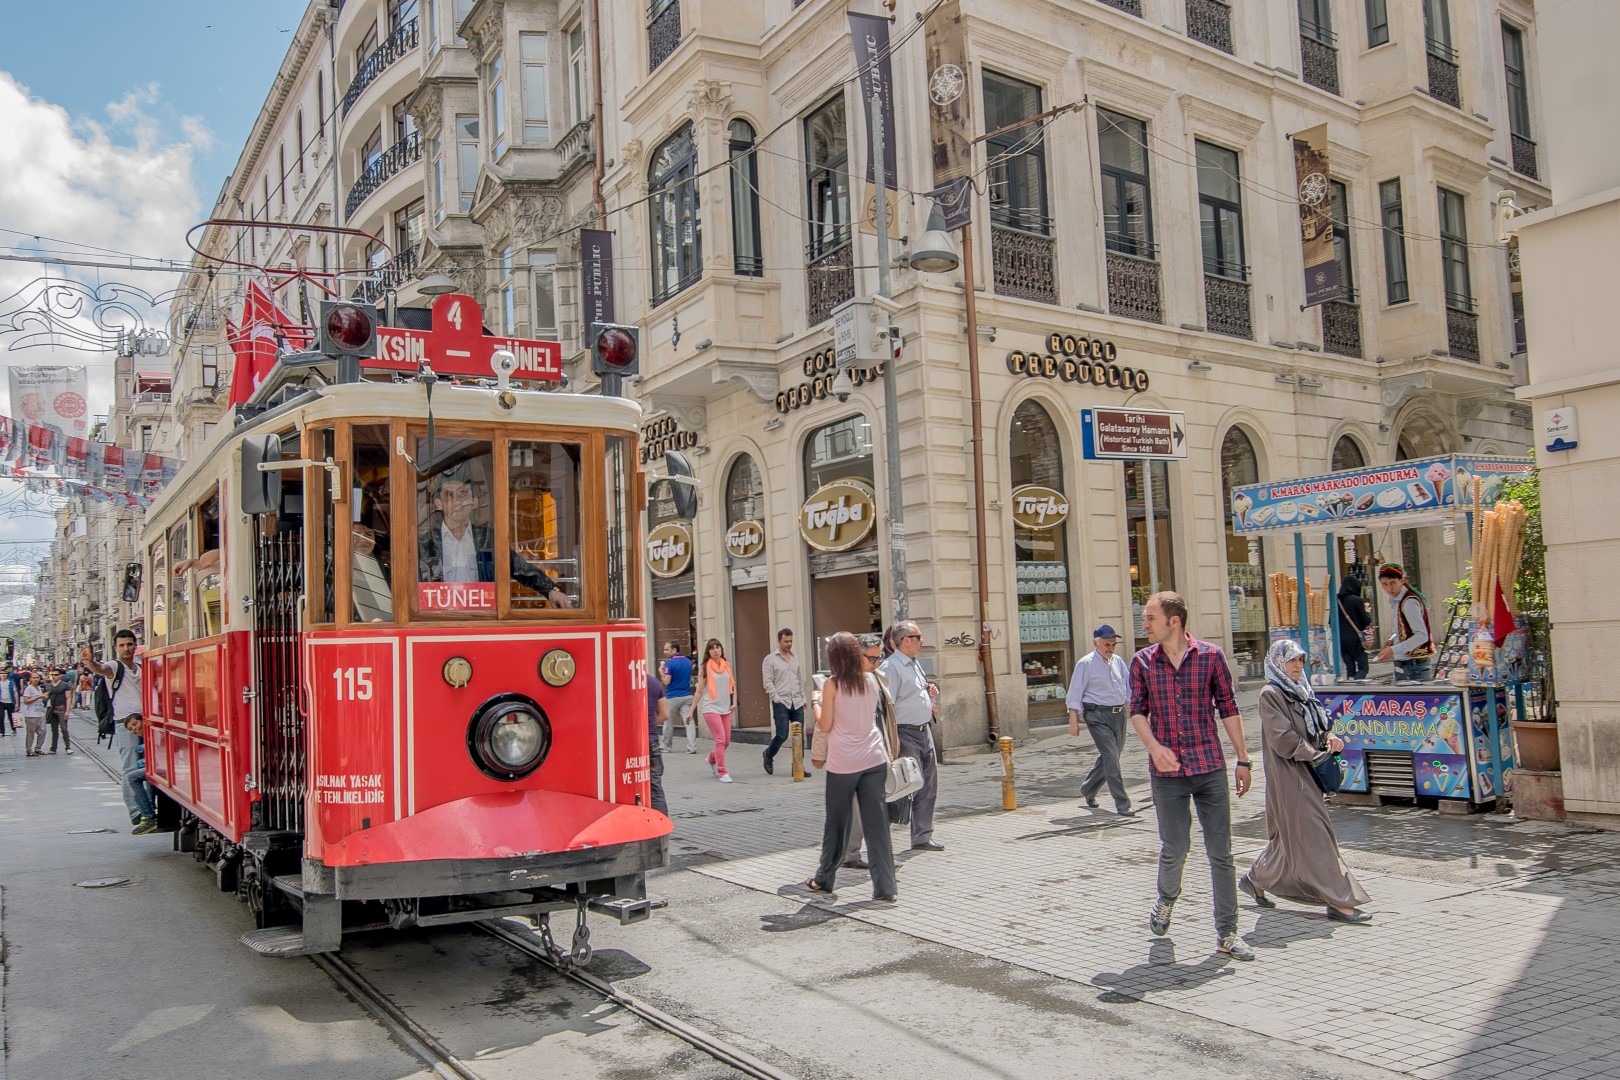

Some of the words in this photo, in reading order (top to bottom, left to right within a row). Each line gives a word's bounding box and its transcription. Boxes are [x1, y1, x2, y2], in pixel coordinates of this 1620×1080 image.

[592, 245, 602, 296] PUBLIC
[447, 301, 462, 331] 4
[376, 332, 425, 363] KSİM
[1051, 336, 1114, 360] HOTEL
[806, 350, 835, 375] HOT
[1012, 354, 1055, 376] THE
[1064, 362, 1146, 389] PUBLIC
[778, 385, 808, 412] THE
[1100, 423, 1140, 435] Galatasaray
[1142, 425, 1169, 435] Hamamı
[1124, 414, 1145, 424] Tarihi
[1122, 444, 1137, 452] Since
[1132, 436, 1154, 445] Turkish
[1270, 483, 1311, 499] K.MARAŞ
[1312, 477, 1359, 494] MARKADO
[1361, 469, 1419, 487] DONDURMA
[423, 586, 491, 608] TÜNEL
[332, 666, 373, 701] 115
[628, 659, 647, 690] 115
[1334, 720, 1439, 737] DONDURMA
[316, 774, 346, 788] ASILMAK
[350, 774, 382, 788] YASAK
[622, 772, 632, 784] VE
[324, 789, 384, 804] TEHLİKELİDİR
